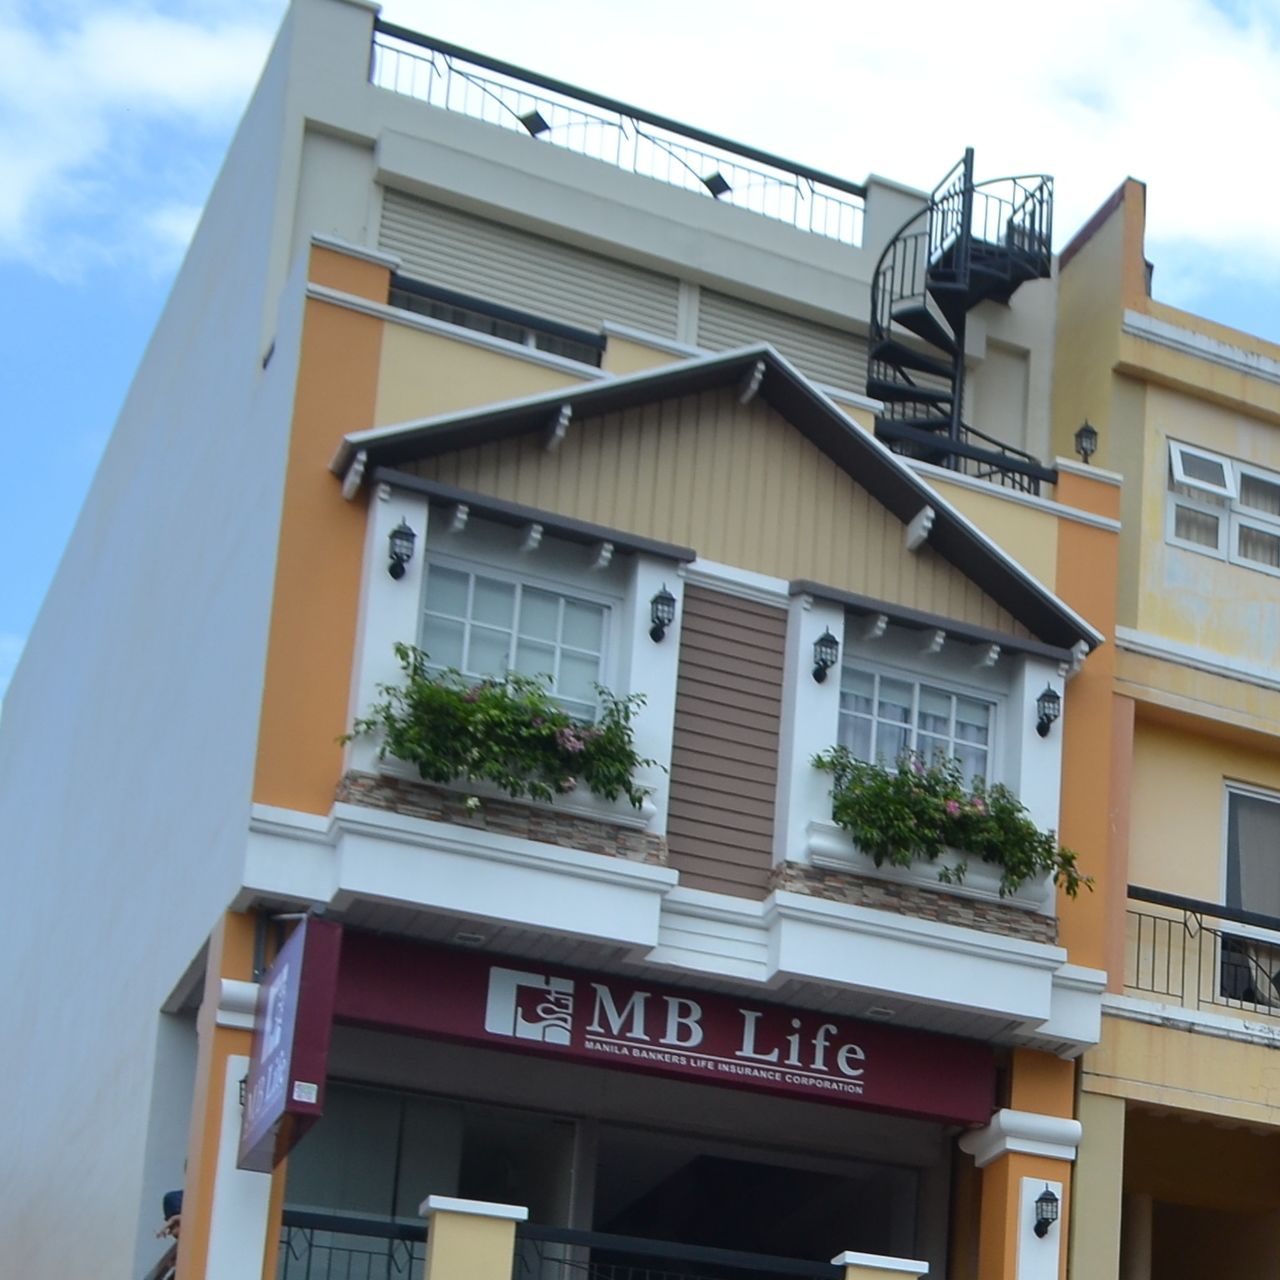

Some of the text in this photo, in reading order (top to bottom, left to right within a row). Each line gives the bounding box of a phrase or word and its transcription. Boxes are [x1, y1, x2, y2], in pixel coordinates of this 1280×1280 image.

[586, 982, 867, 1077] MB Life
[584, 1040, 864, 1095] MANILA BANKERS LIFE INSURANCE CORPORATION
